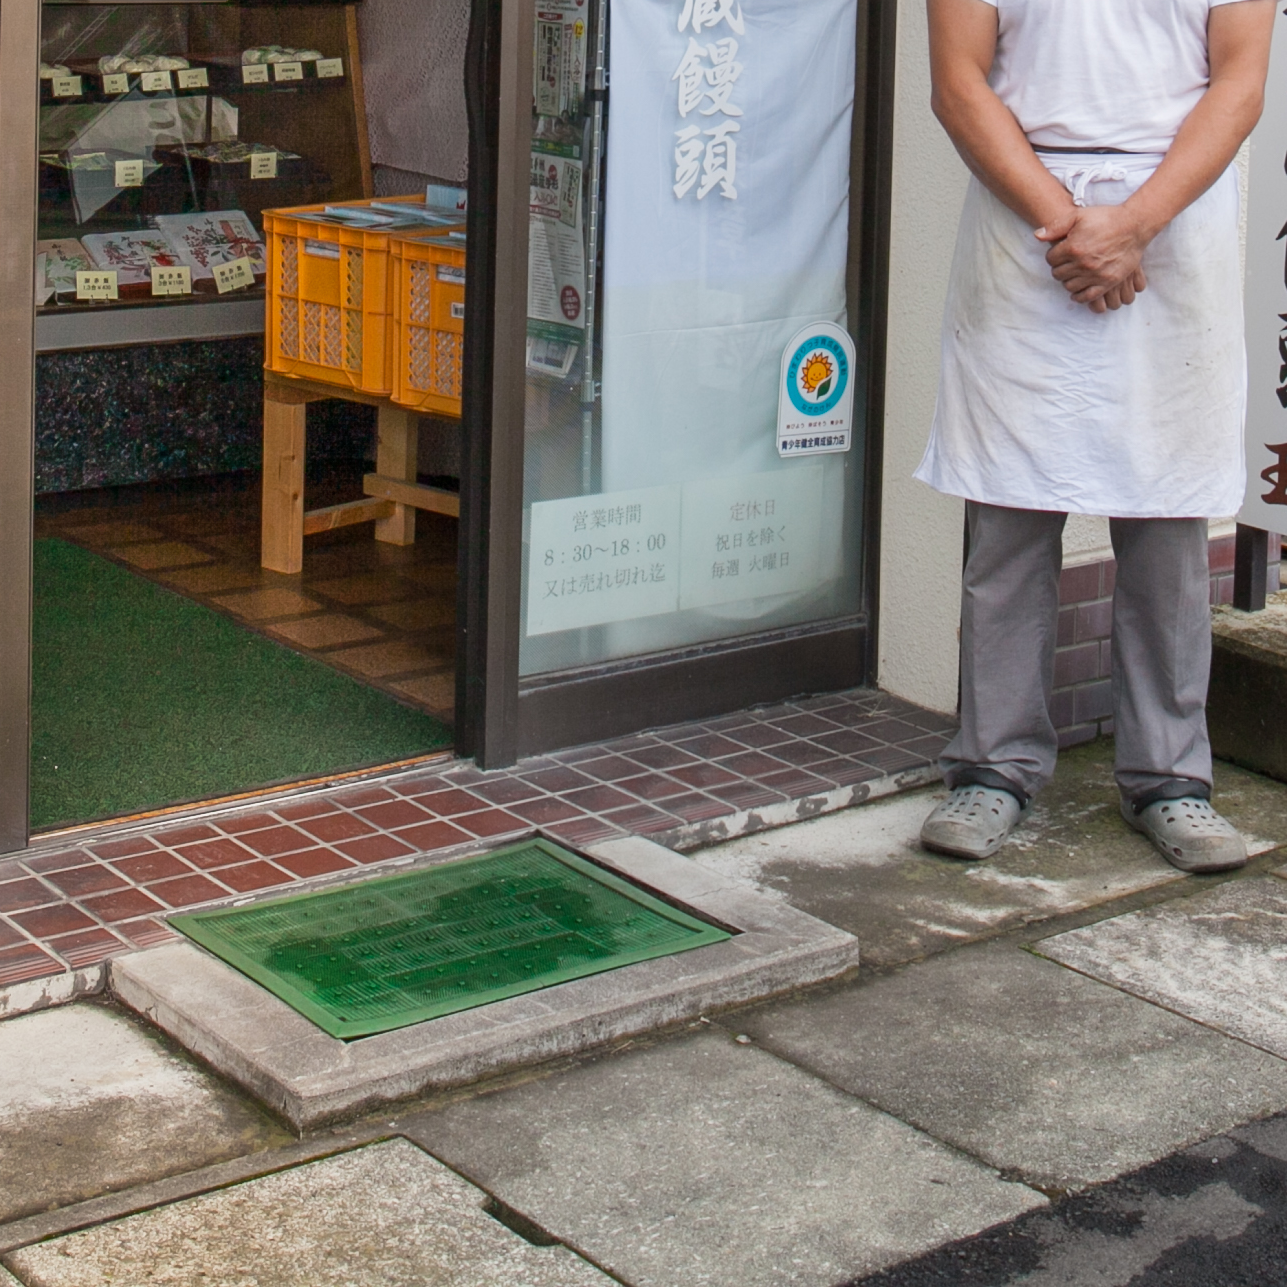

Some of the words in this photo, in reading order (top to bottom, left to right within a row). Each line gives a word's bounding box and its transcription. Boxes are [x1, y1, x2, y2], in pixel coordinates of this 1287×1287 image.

[572, 504, 642, 532] 営業時間
[730, 499, 776, 522] 定休日
[712, 559, 740, 581] 毎週
[748, 552, 791, 573] 火曜日
